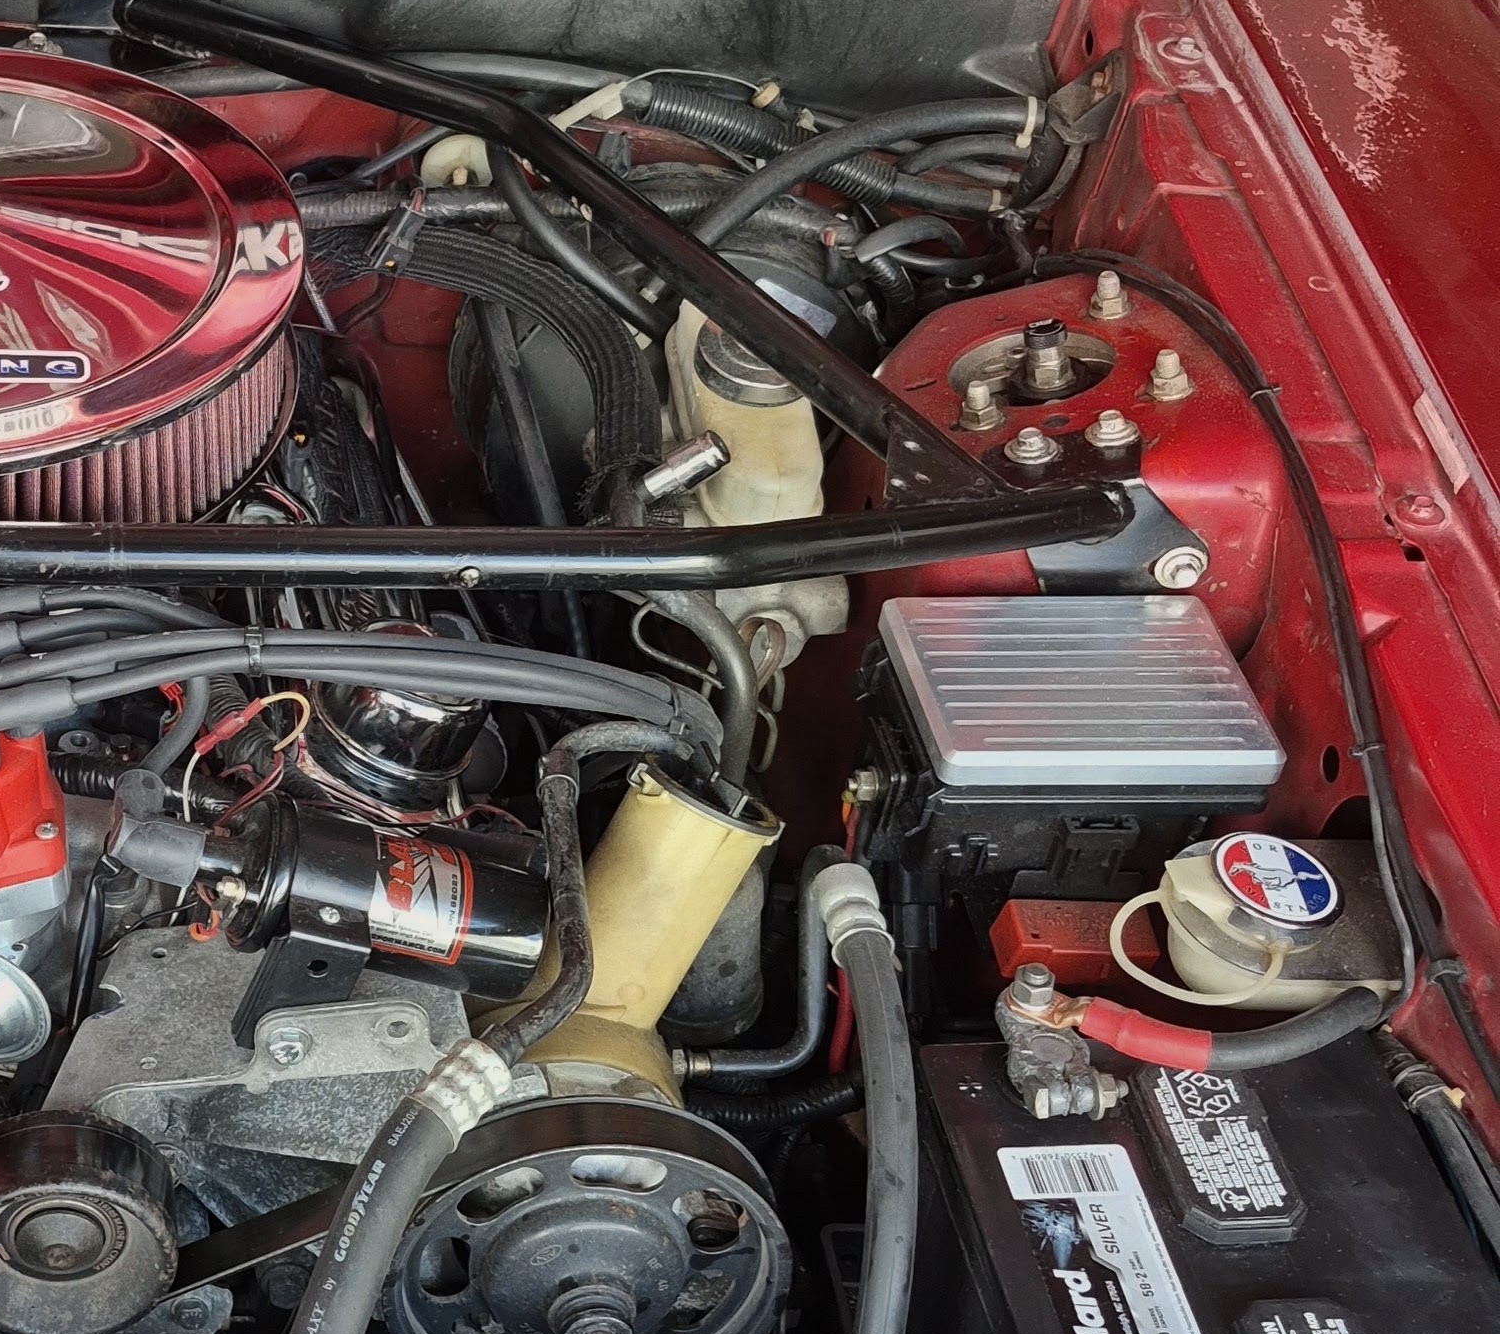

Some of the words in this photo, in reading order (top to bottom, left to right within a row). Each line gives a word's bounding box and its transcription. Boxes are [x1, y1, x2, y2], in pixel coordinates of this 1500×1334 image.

[322, 1277, 338, 1291] by
[333, 1158, 387, 1263] GOODYEAR
[1088, 1203, 1121, 1255] SILVER
